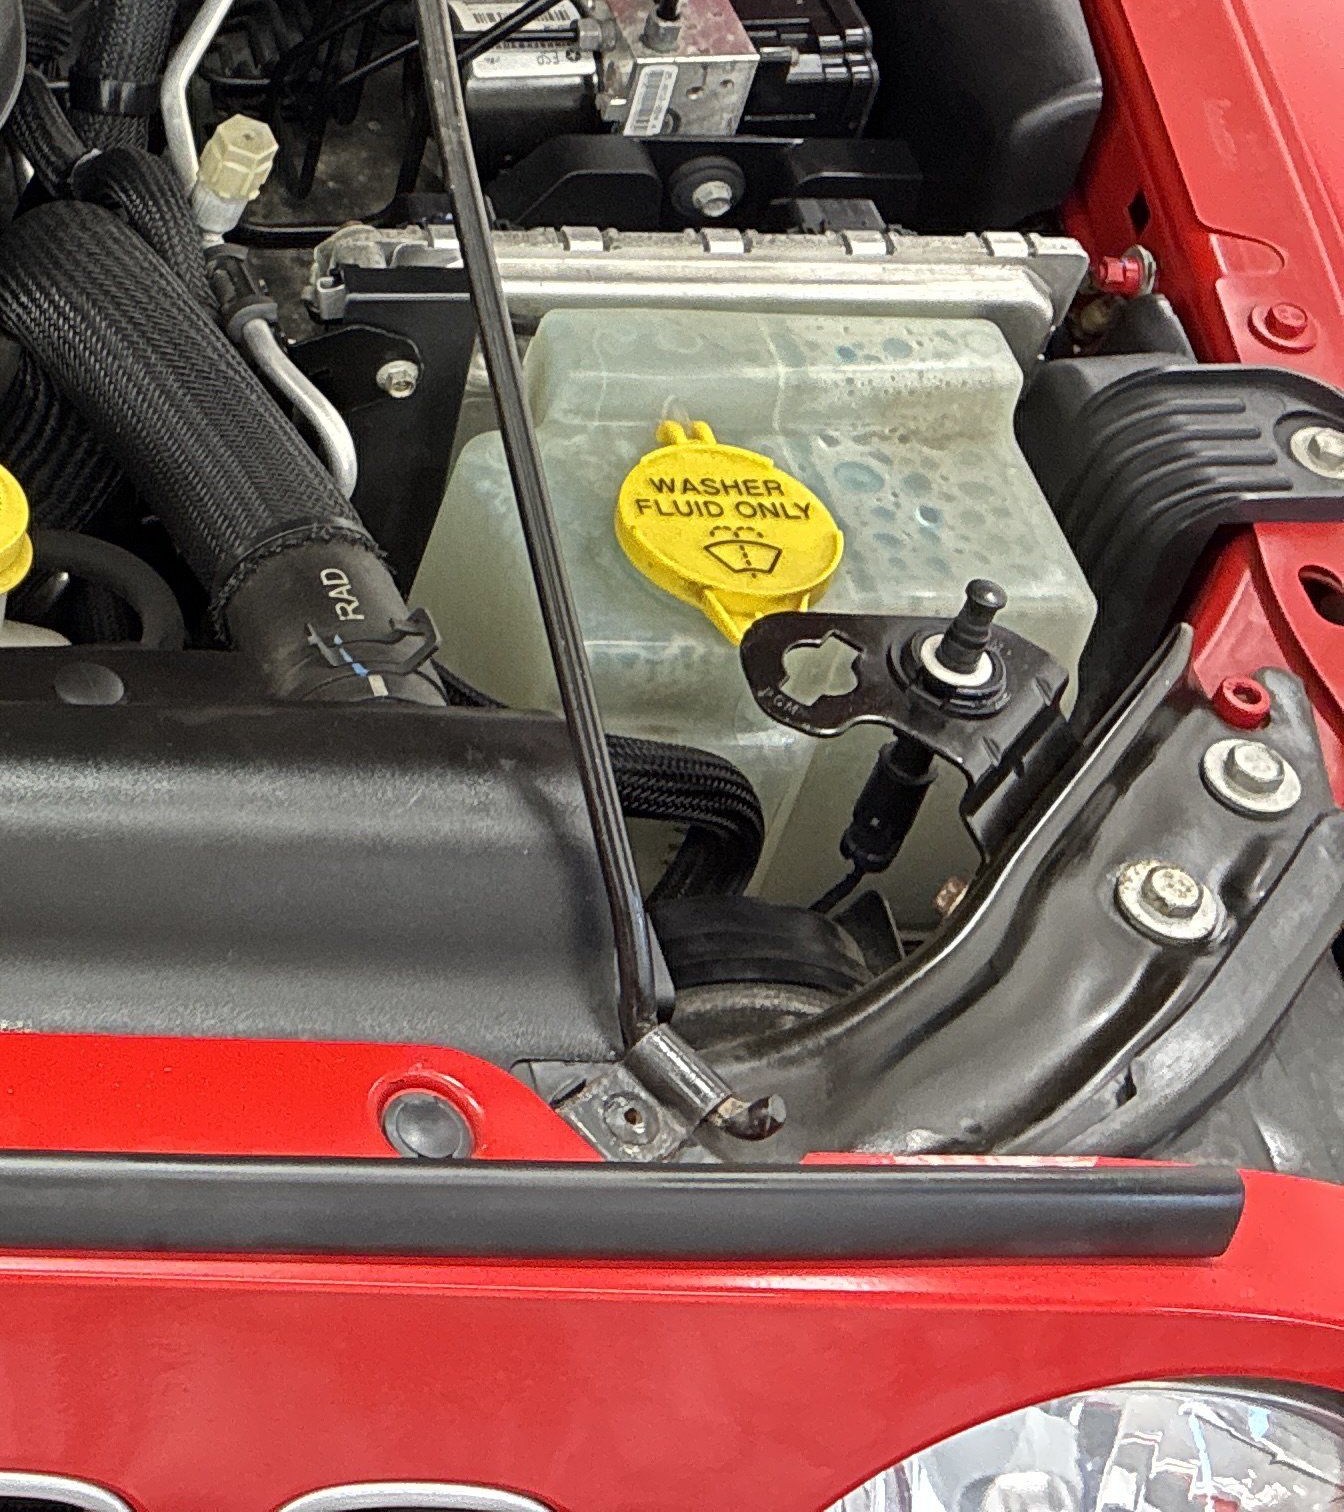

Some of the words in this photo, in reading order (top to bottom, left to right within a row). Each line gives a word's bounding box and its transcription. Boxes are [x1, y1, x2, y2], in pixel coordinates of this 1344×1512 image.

[648, 476, 785, 497] WASHER
[634, 498, 725, 518] FLUID
[734, 500, 812, 520] ONLY
[320, 568, 365, 621] RAD
